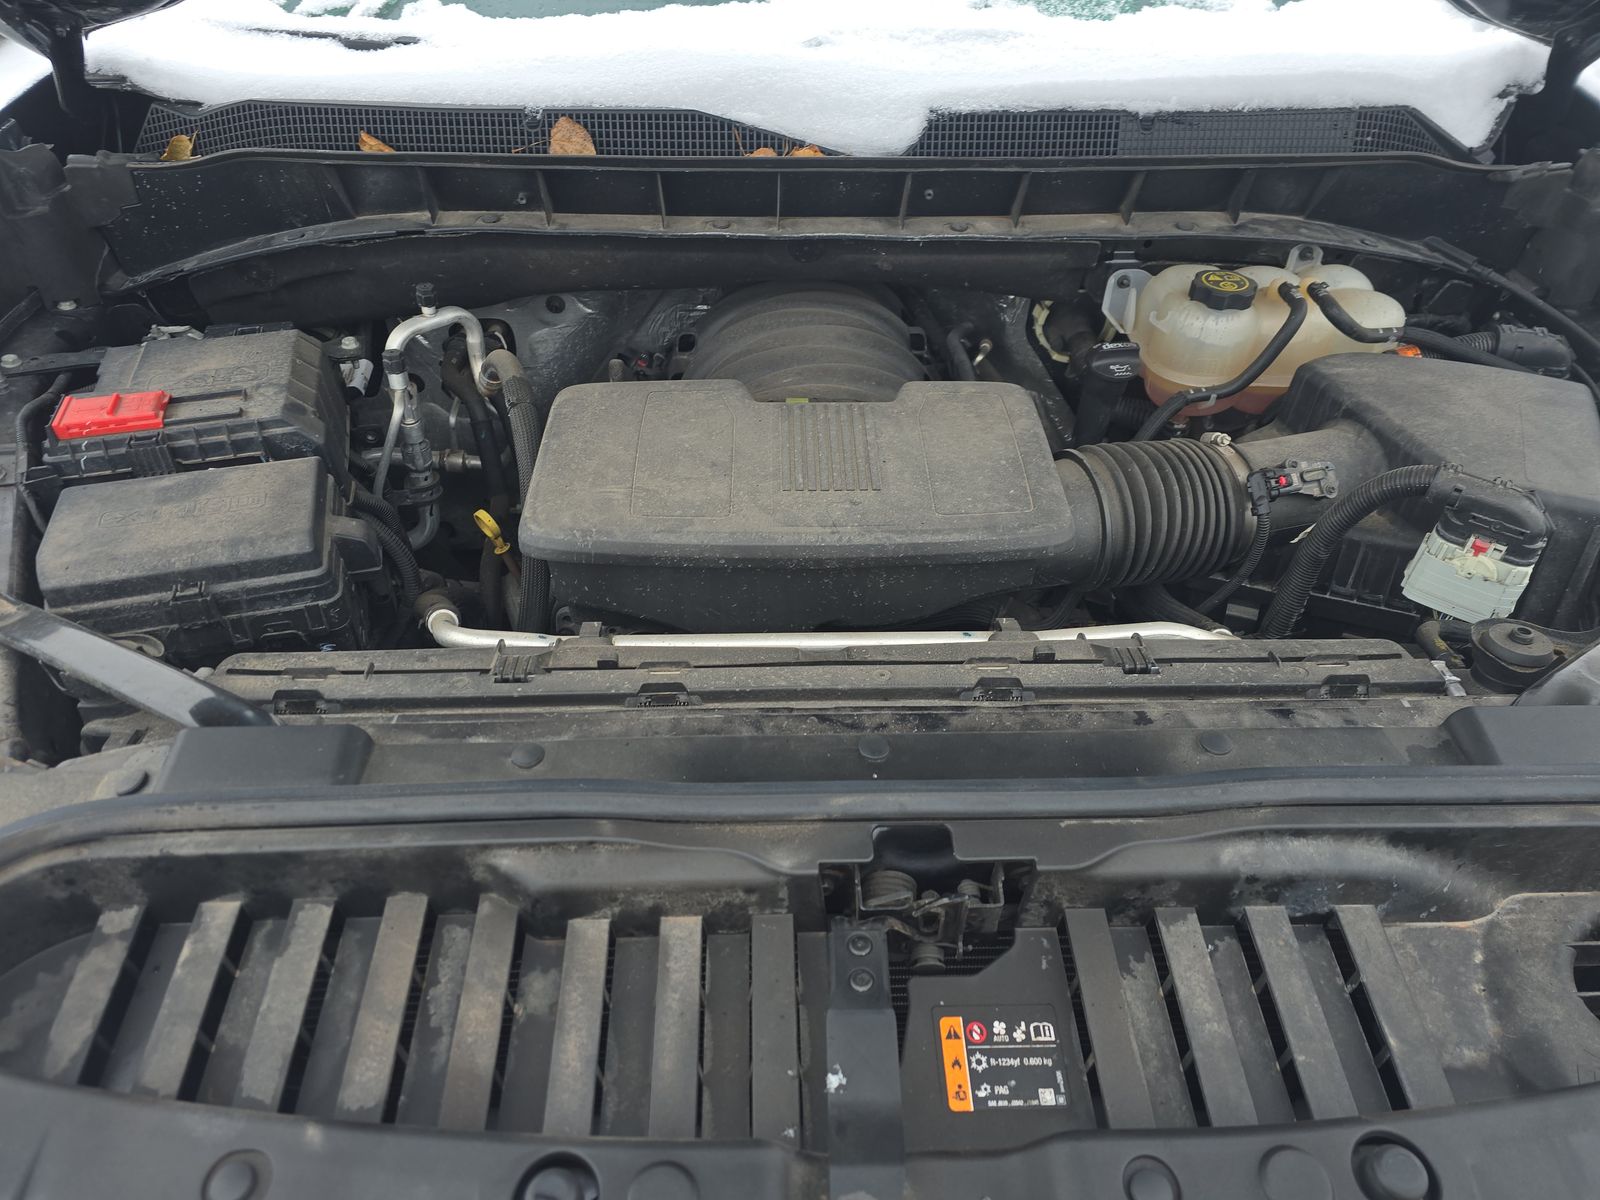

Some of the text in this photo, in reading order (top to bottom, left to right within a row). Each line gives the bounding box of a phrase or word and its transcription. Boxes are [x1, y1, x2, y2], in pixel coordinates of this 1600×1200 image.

[993, 1034, 1009, 1042] AUTO
[1023, 1057, 1043, 1066] 0.600
[1043, 1057, 1052, 1067] kg
[994, 1085, 1009, 1095] PAG
